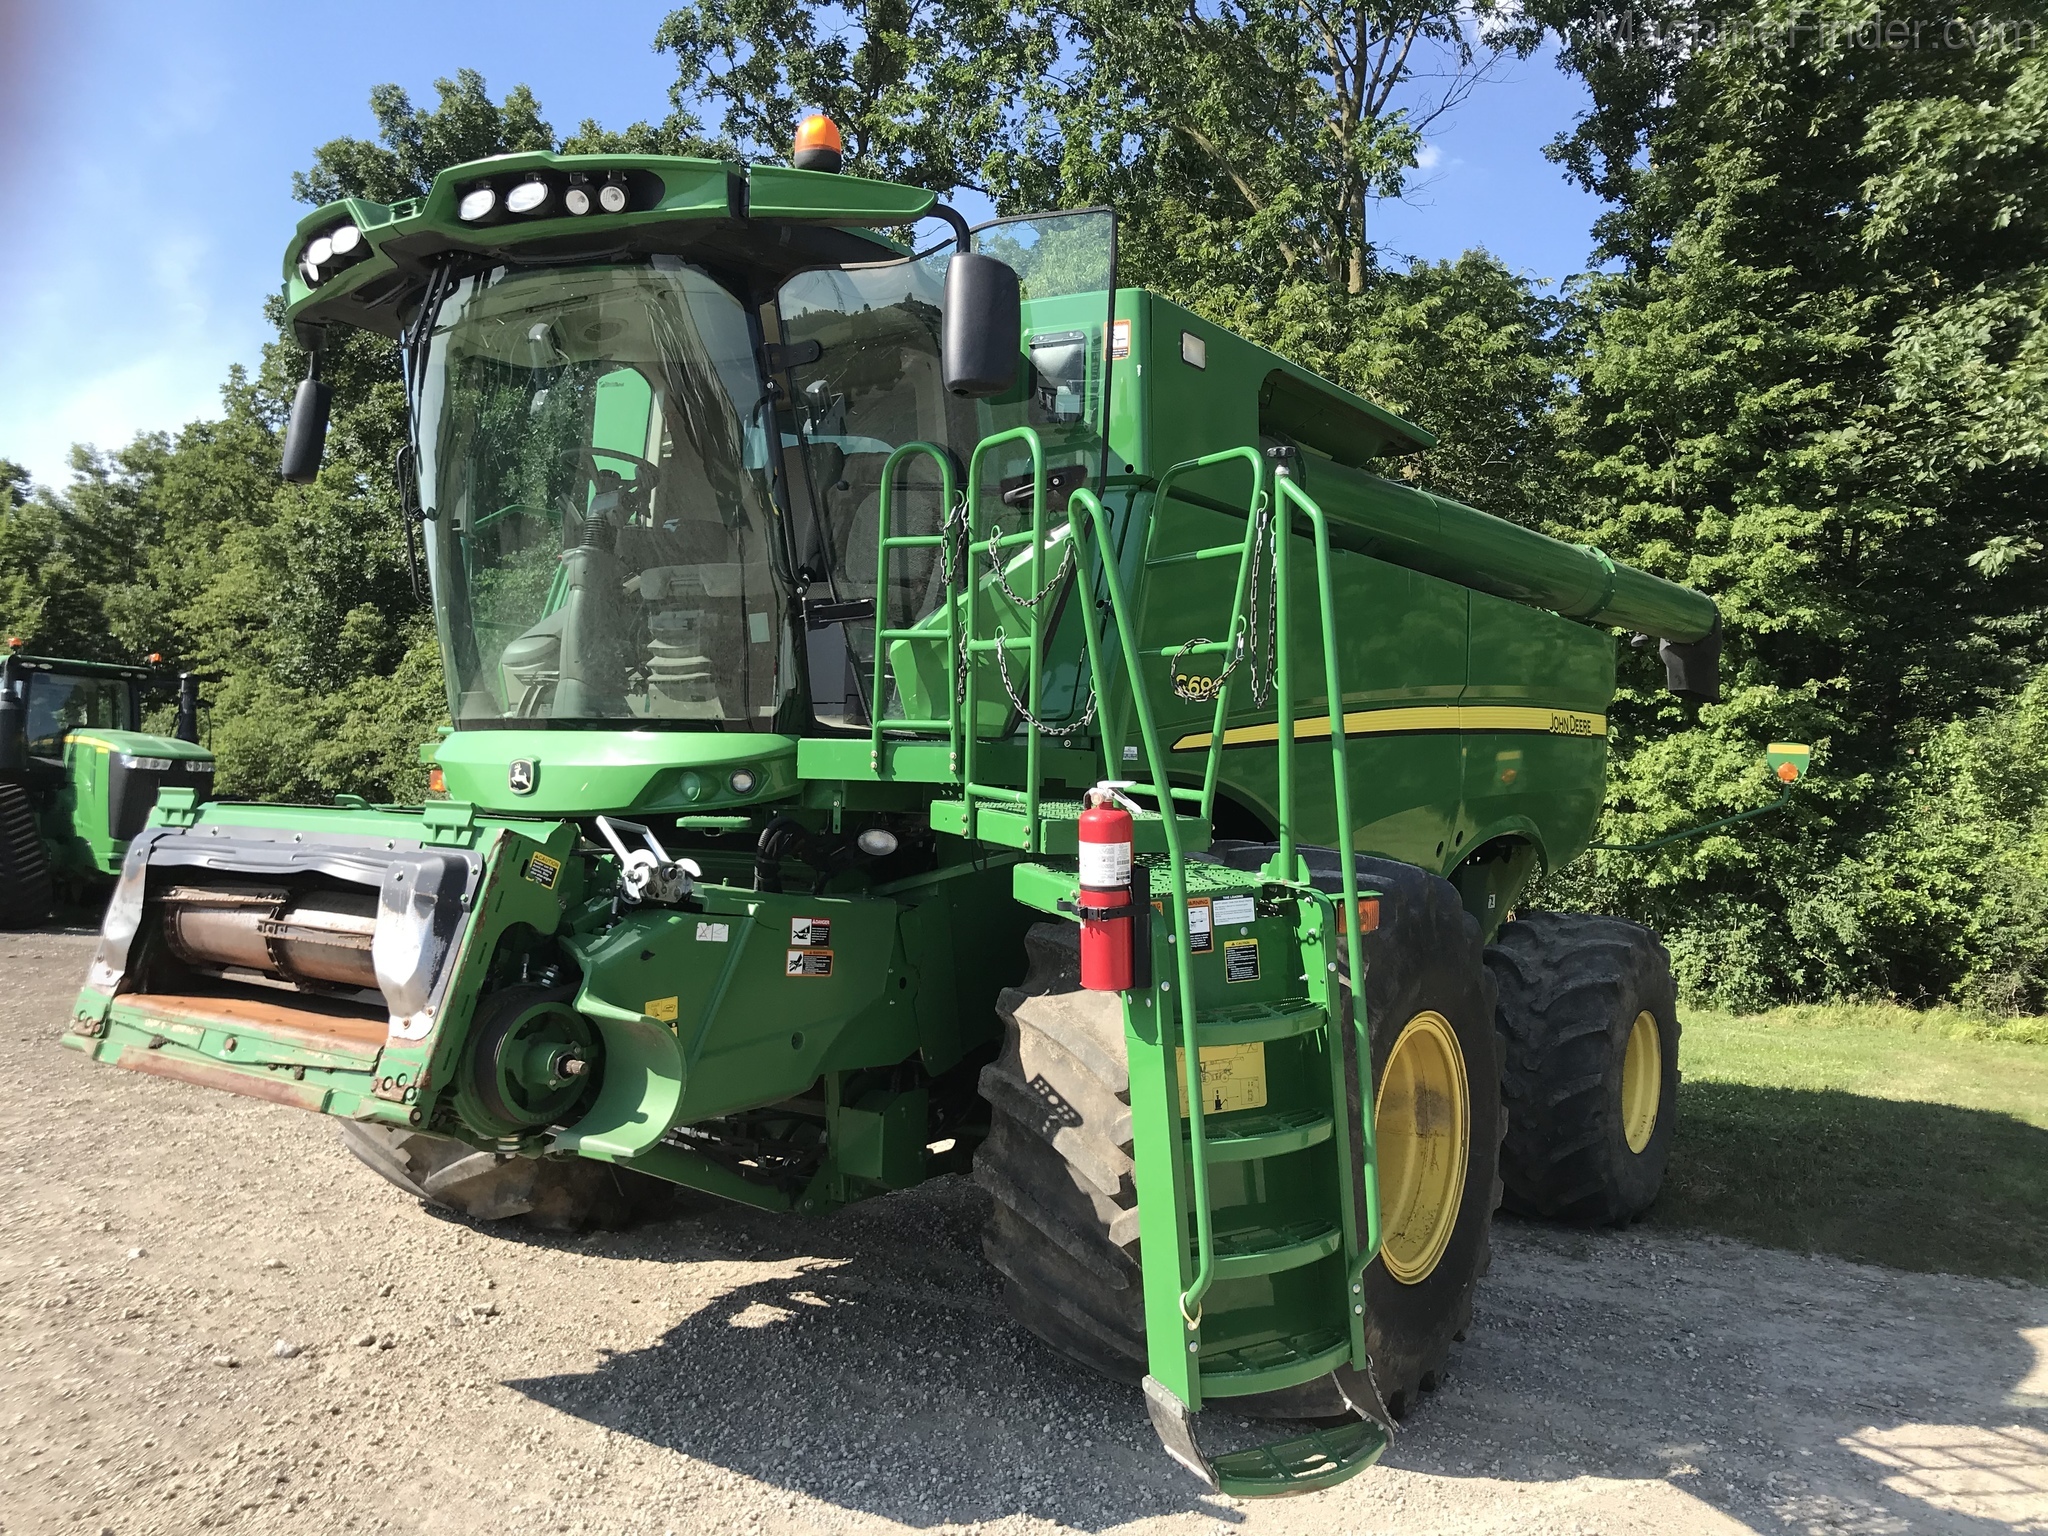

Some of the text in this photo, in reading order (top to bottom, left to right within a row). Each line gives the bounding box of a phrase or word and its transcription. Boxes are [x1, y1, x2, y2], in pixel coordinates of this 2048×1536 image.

[1550, 713, 1592, 735] JOHN DEERE
[538, 855, 560, 868] CAUTION
